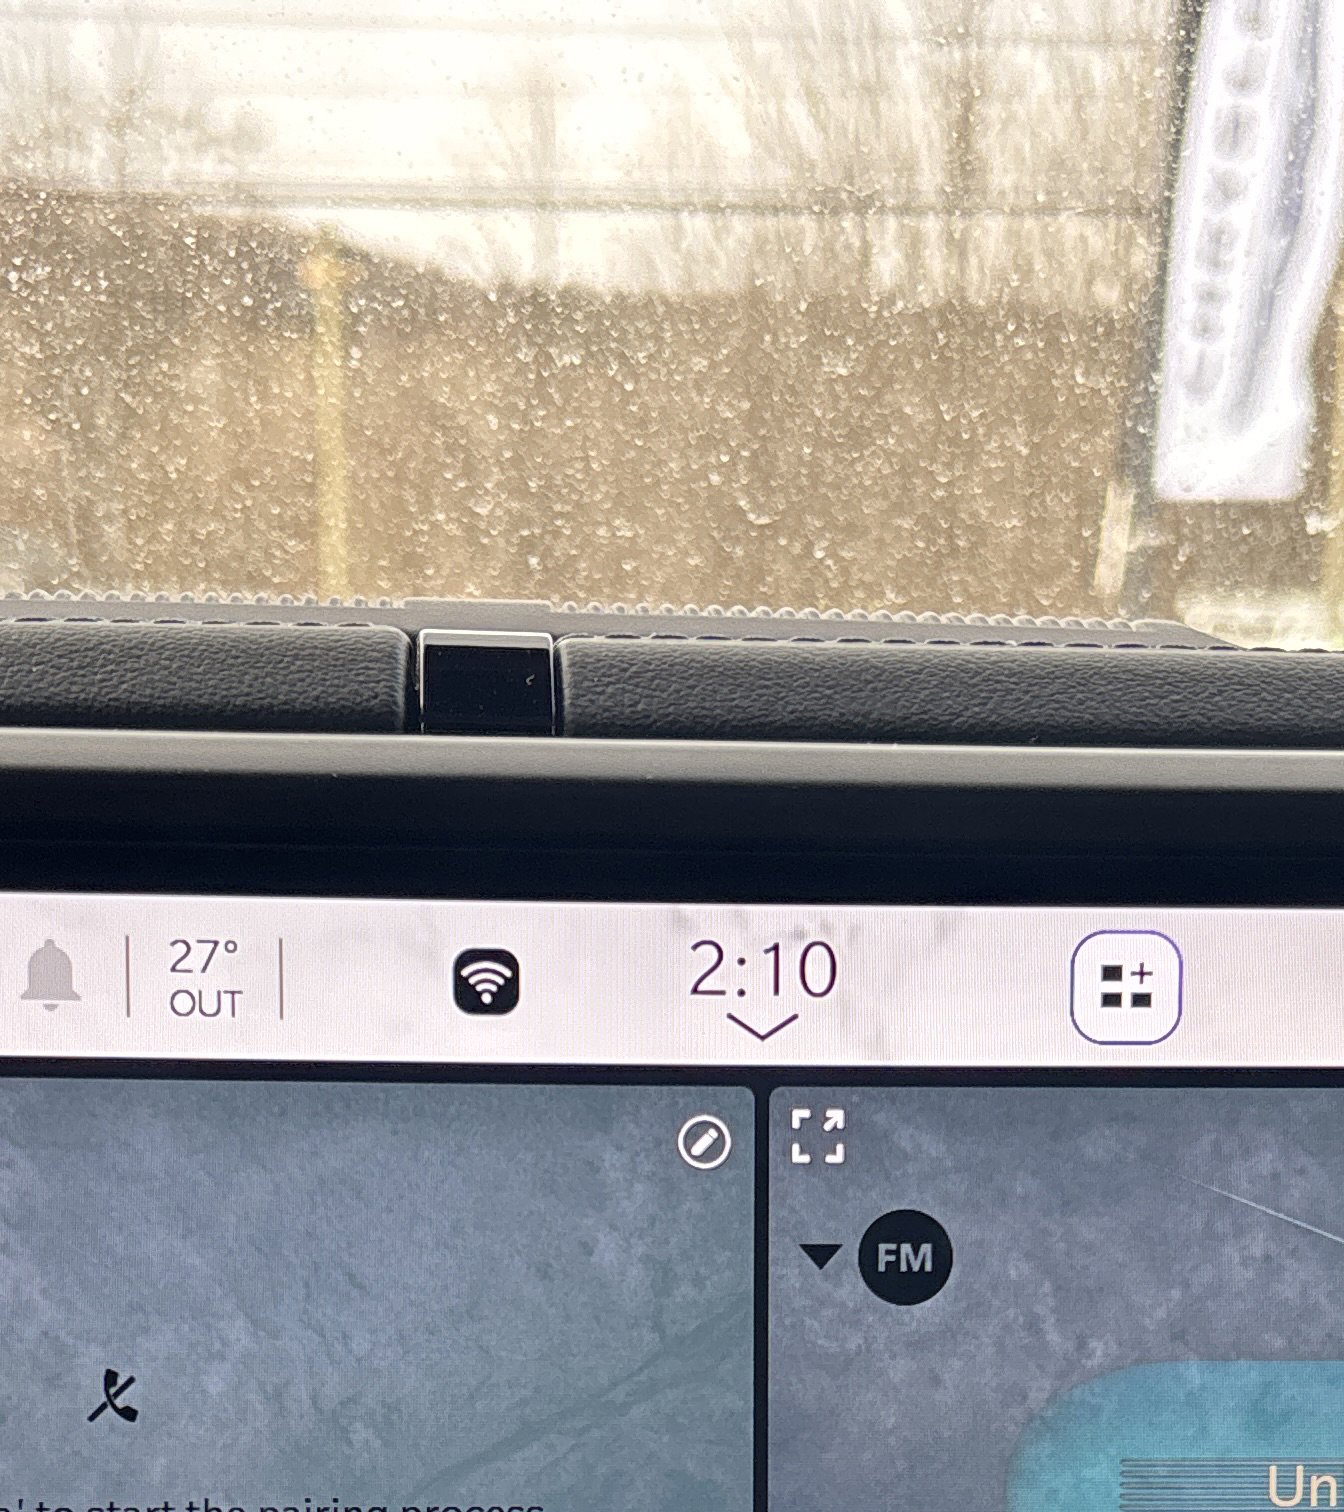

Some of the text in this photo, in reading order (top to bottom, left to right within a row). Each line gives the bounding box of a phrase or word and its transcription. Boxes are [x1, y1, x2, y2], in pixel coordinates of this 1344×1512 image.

[690, 940, 838, 998] 2:10
[169, 989, 244, 1018] OUT
[877, 1243, 934, 1274] FM
